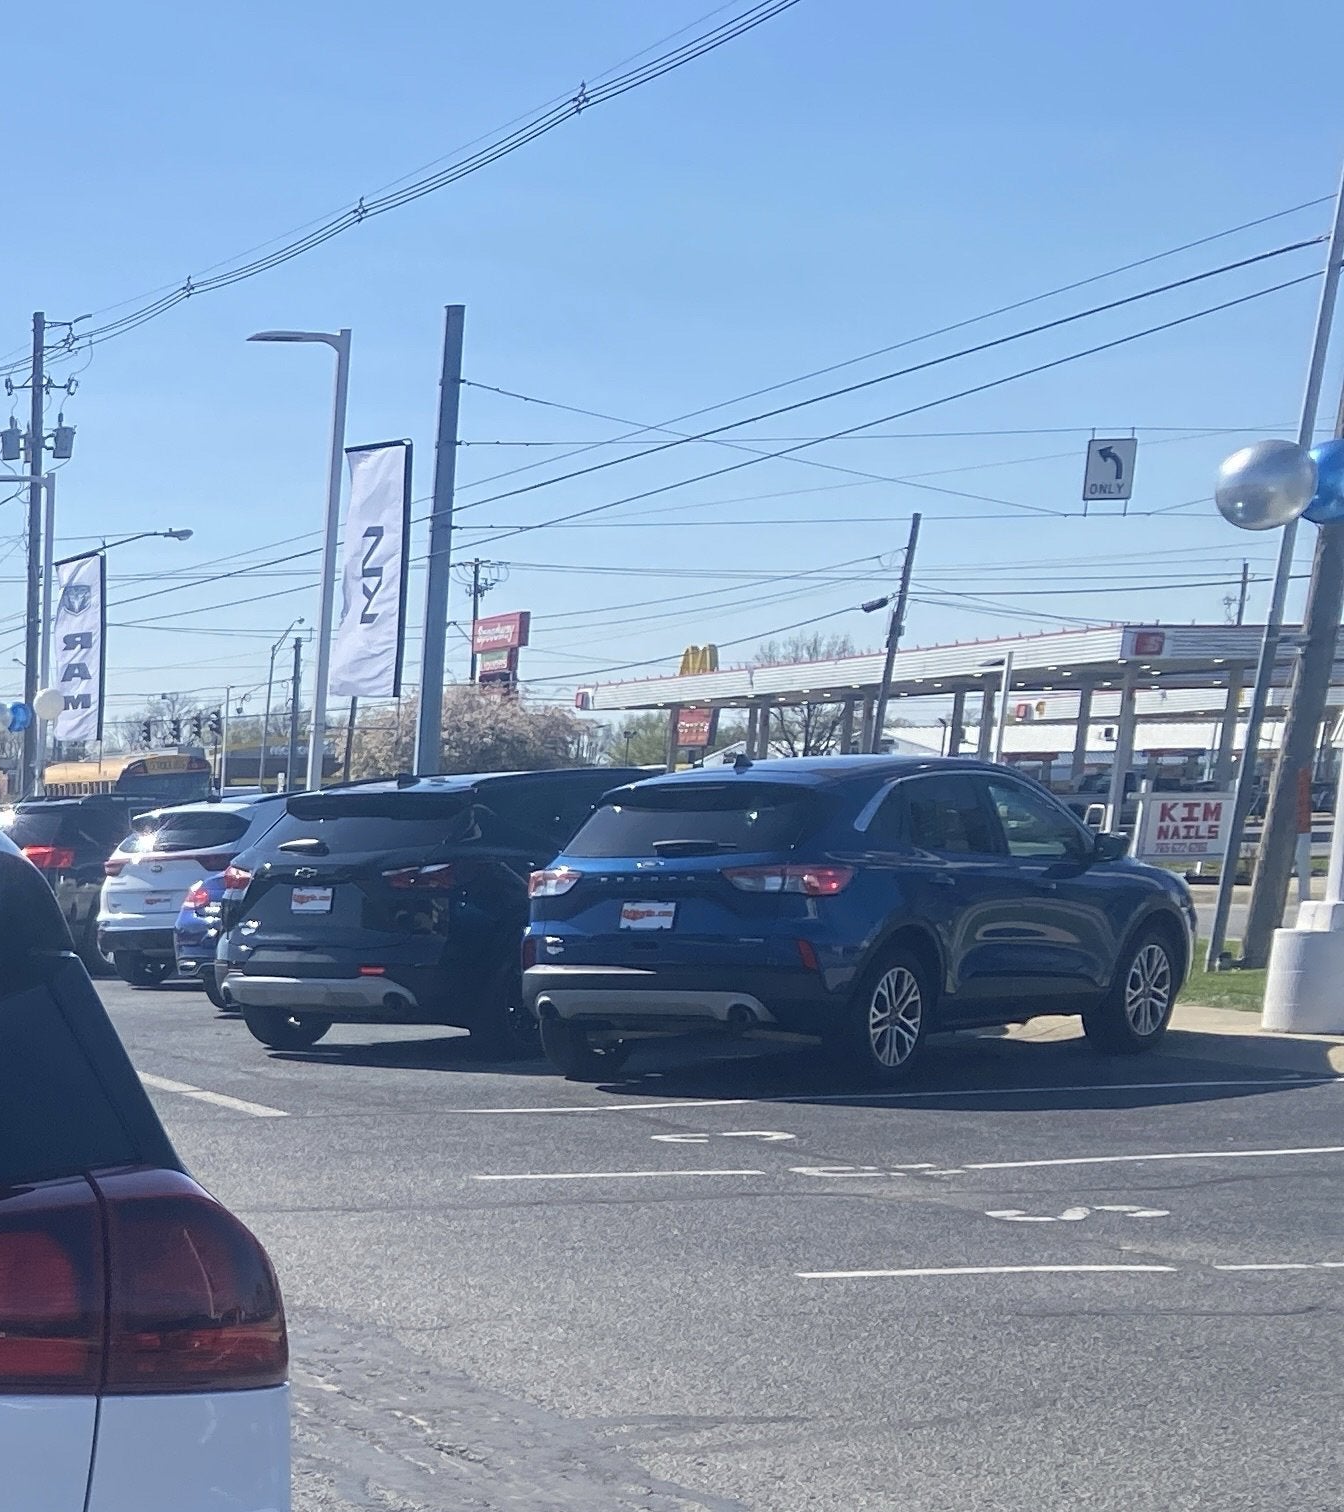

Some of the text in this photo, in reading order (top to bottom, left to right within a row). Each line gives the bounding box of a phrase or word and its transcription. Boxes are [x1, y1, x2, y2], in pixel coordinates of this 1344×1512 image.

[1089, 483, 1124, 495] ONLY
[1160, 803, 1222, 822] KIM
[1157, 826, 1219, 839] NAILS
